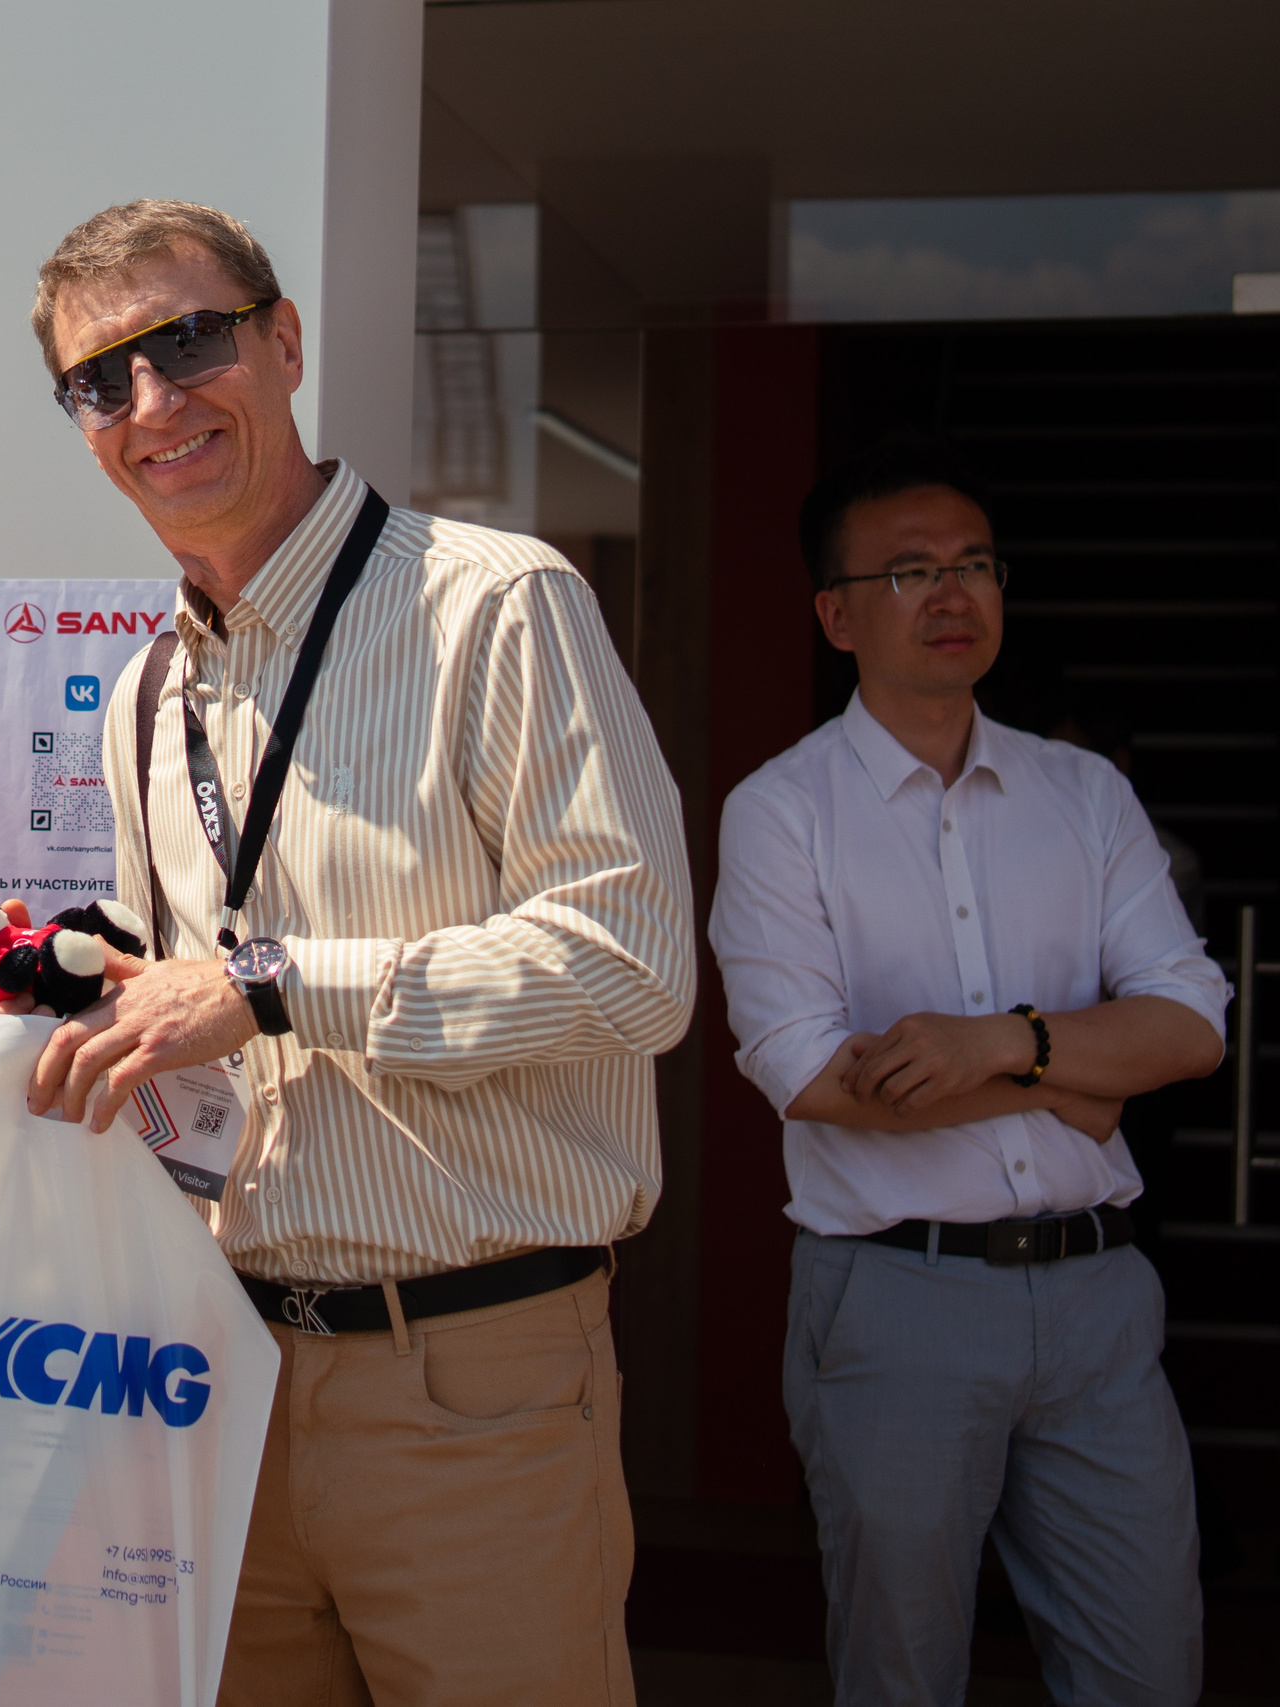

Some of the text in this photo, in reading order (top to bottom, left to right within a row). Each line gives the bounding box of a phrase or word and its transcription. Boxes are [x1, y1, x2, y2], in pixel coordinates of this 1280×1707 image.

[57, 612, 166, 635] SANY
[70, 685, 95, 703] VK
[70, 777, 105, 787] SANY
[46, 845, 113, 853] vk.com/sanyofficial
[12, 879, 21, 889] И
[25, 878, 114, 891] УЧАСТВУЙТЕ
[178, 1170, 210, 1190] Visitor
[0, 1574, 47, 1590] России
[100, 1587, 166, 1606] xcmg-ru.ru
